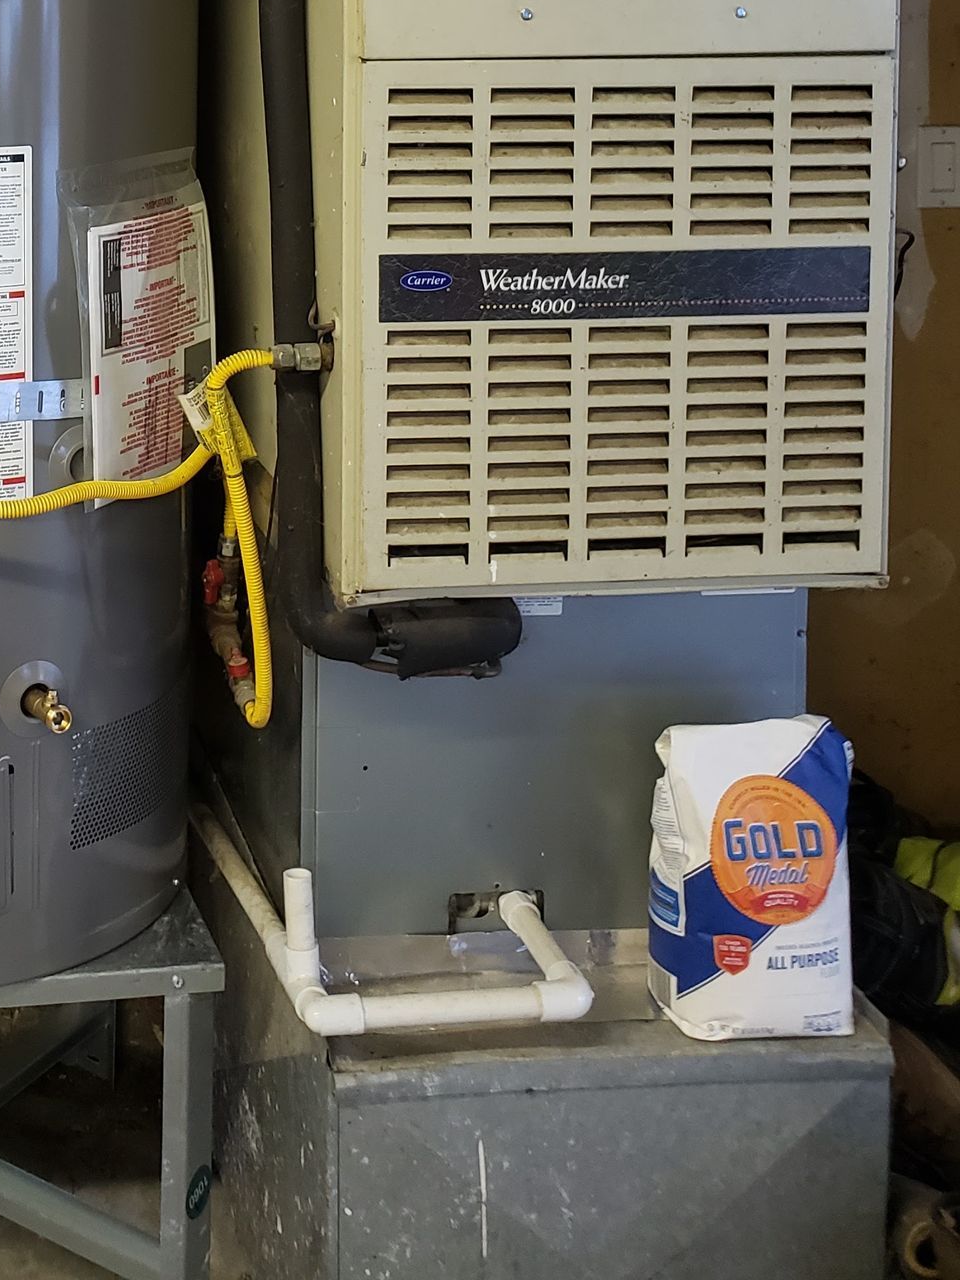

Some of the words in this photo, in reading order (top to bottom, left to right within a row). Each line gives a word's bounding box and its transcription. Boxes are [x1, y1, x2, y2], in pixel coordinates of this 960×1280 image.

[406, 275, 448, 288] Carrier
[479, 267, 630, 292] WeatherMaker
[530, 298, 576, 315] 8000
[722, 818, 824, 863] GOLD
[744, 861, 809, 892] Medal
[766, 956, 787, 970] ALL
[790, 947, 839, 969] PURPOSE
